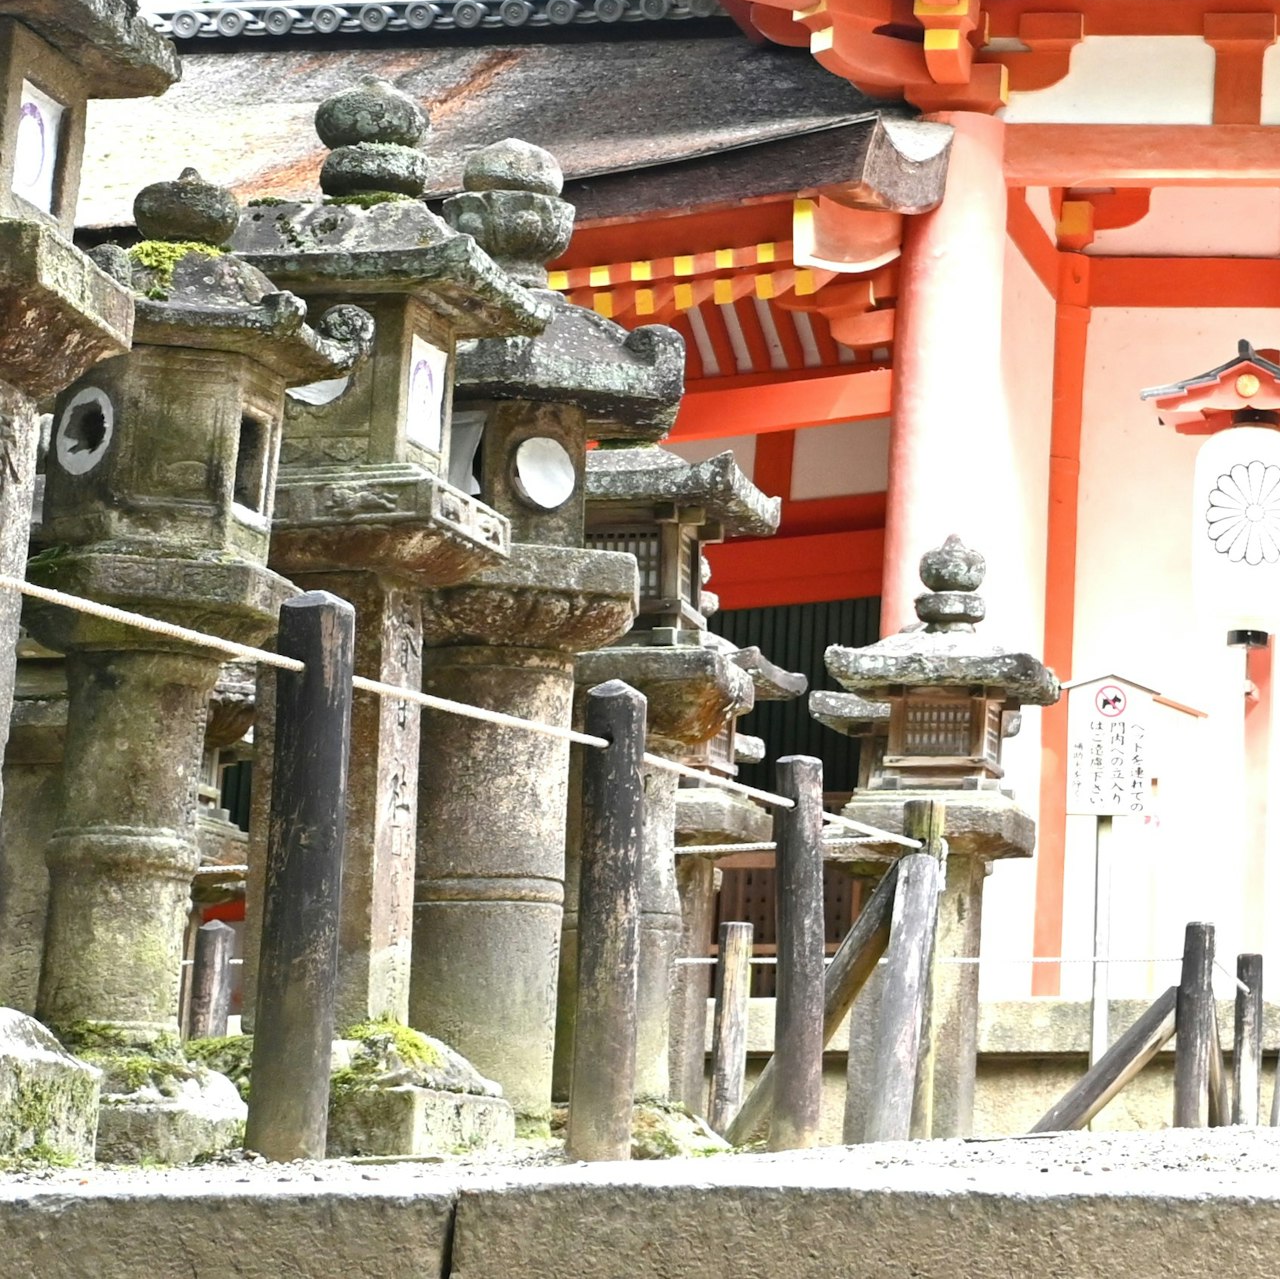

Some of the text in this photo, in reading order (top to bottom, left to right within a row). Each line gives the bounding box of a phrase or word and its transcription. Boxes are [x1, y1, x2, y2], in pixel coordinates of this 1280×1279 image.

[1110, 721, 1125, 805] 門内への立入り
